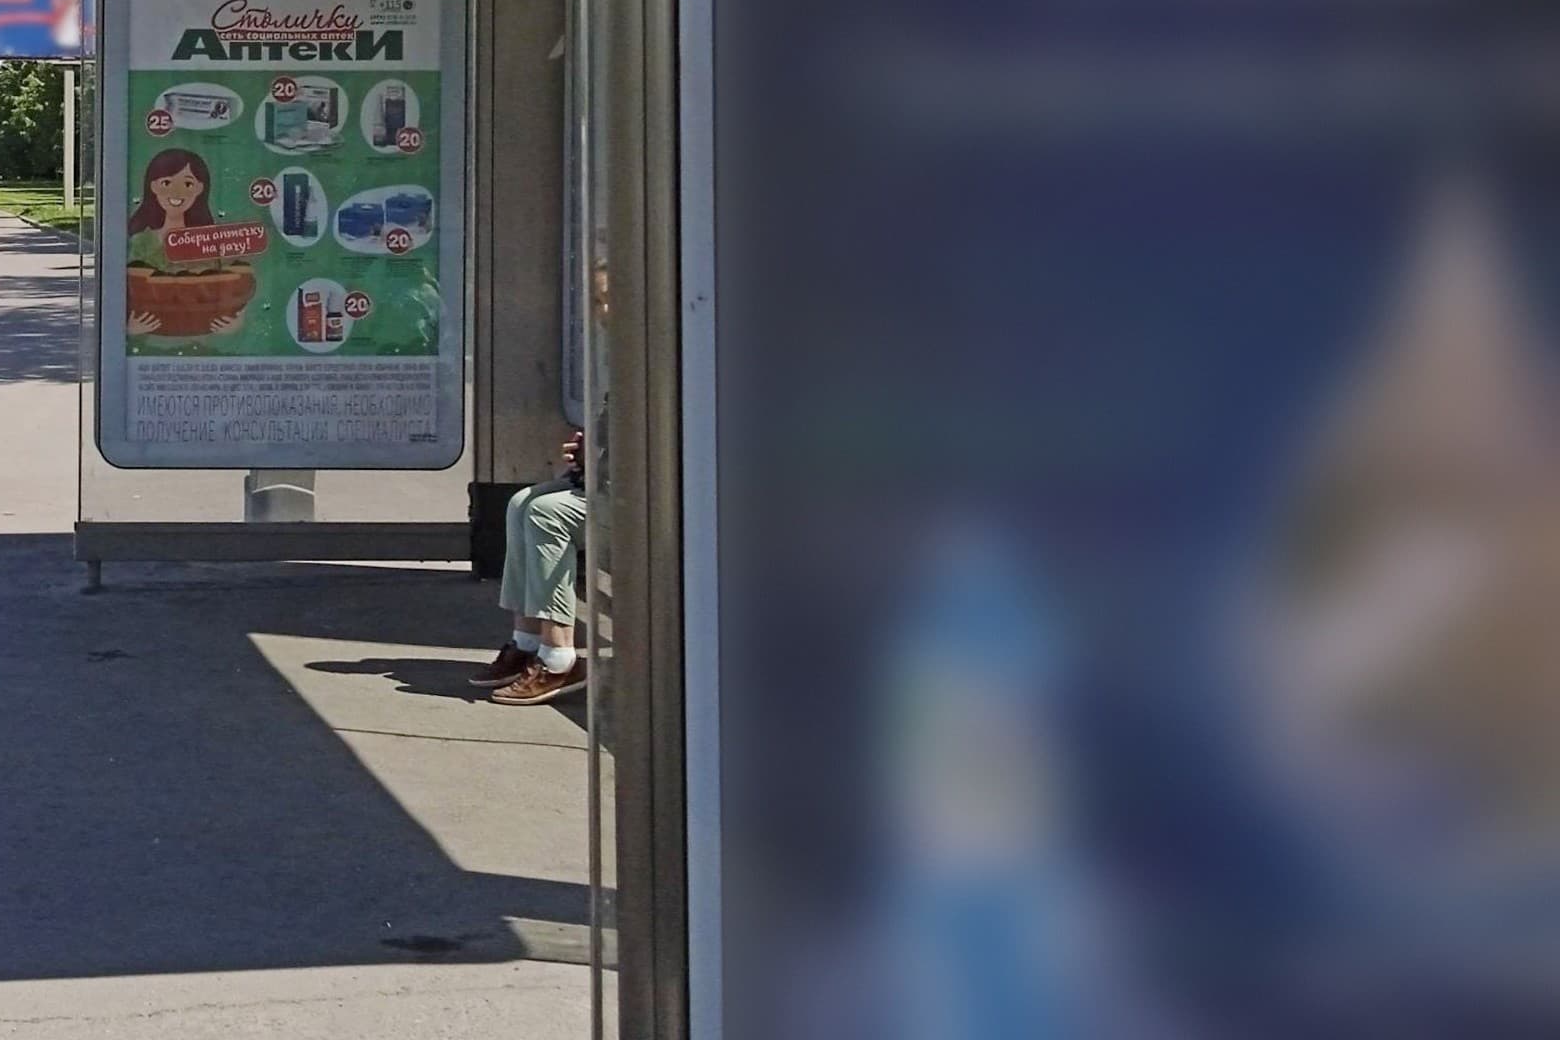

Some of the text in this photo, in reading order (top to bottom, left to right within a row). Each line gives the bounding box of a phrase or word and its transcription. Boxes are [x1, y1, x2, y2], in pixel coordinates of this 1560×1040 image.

[220, 32, 355, 42] сеть социальных аптек
[168, 225, 265, 247] Собери аптечку
[202, 237, 251, 256] на дачу!
[137, 394, 200, 417] ИМЕЮТСЯ
[344, 394, 432, 417] НЕОБХОДИМО
[137, 420, 216, 442] ПОЛУЧЕНИЕ
[223, 420, 328, 442] КОНСУЛЬТАЦИИ
